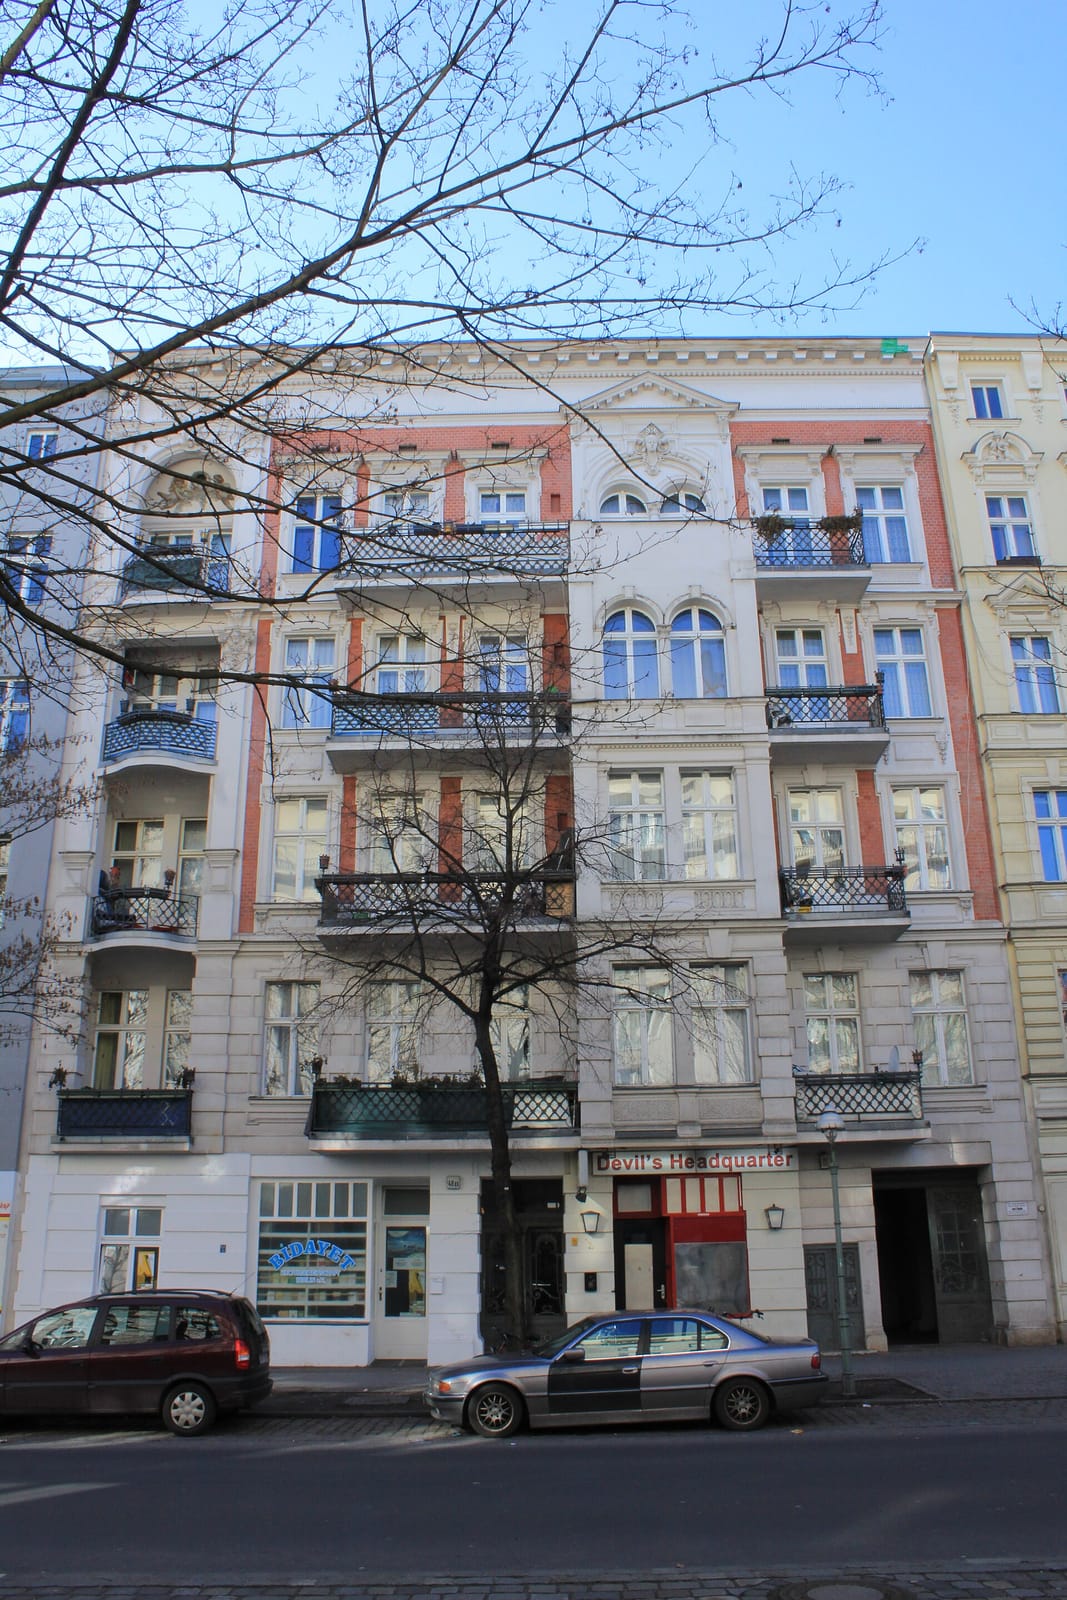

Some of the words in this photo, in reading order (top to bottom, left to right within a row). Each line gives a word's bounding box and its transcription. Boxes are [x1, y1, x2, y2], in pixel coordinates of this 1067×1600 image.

[597, 1153, 663, 1171] Devil's
[670, 1152, 793, 1172] Headquarter
[267, 1239, 356, 1271] BIDAYET
